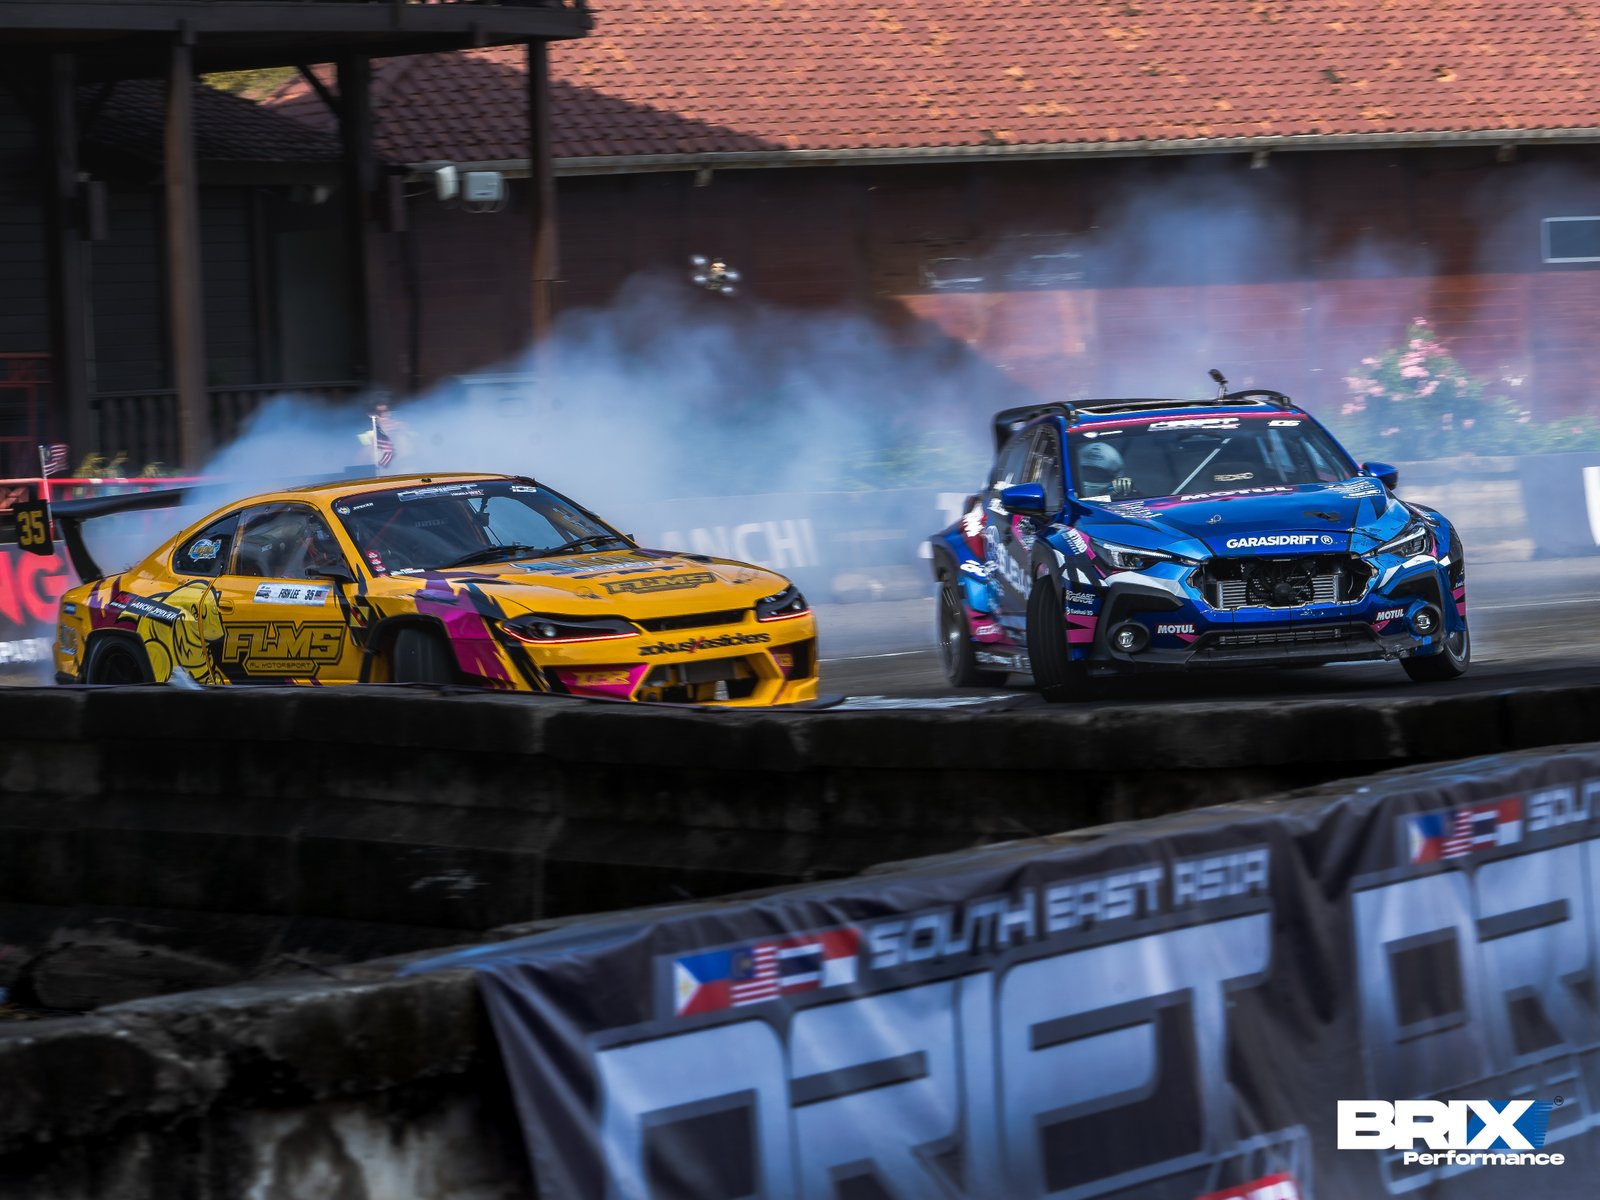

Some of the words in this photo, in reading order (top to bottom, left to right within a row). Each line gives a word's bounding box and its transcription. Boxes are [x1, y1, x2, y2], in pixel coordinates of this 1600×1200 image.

[1180, 486, 1293, 501] MOTUL
[17, 510, 46, 546] 35
[1226, 534, 1318, 549] GARASIDRIFT
[304, 590, 315, 600] 35
[1376, 608, 1404, 621] MOTUL
[1157, 624, 1195, 634] MOTUL
[261, 661, 311, 669] MOTORSPORT
[868, 886, 1037, 969] SOUTH
[1045, 863, 1163, 932] EAST
[1172, 847, 1270, 906] ASIA
